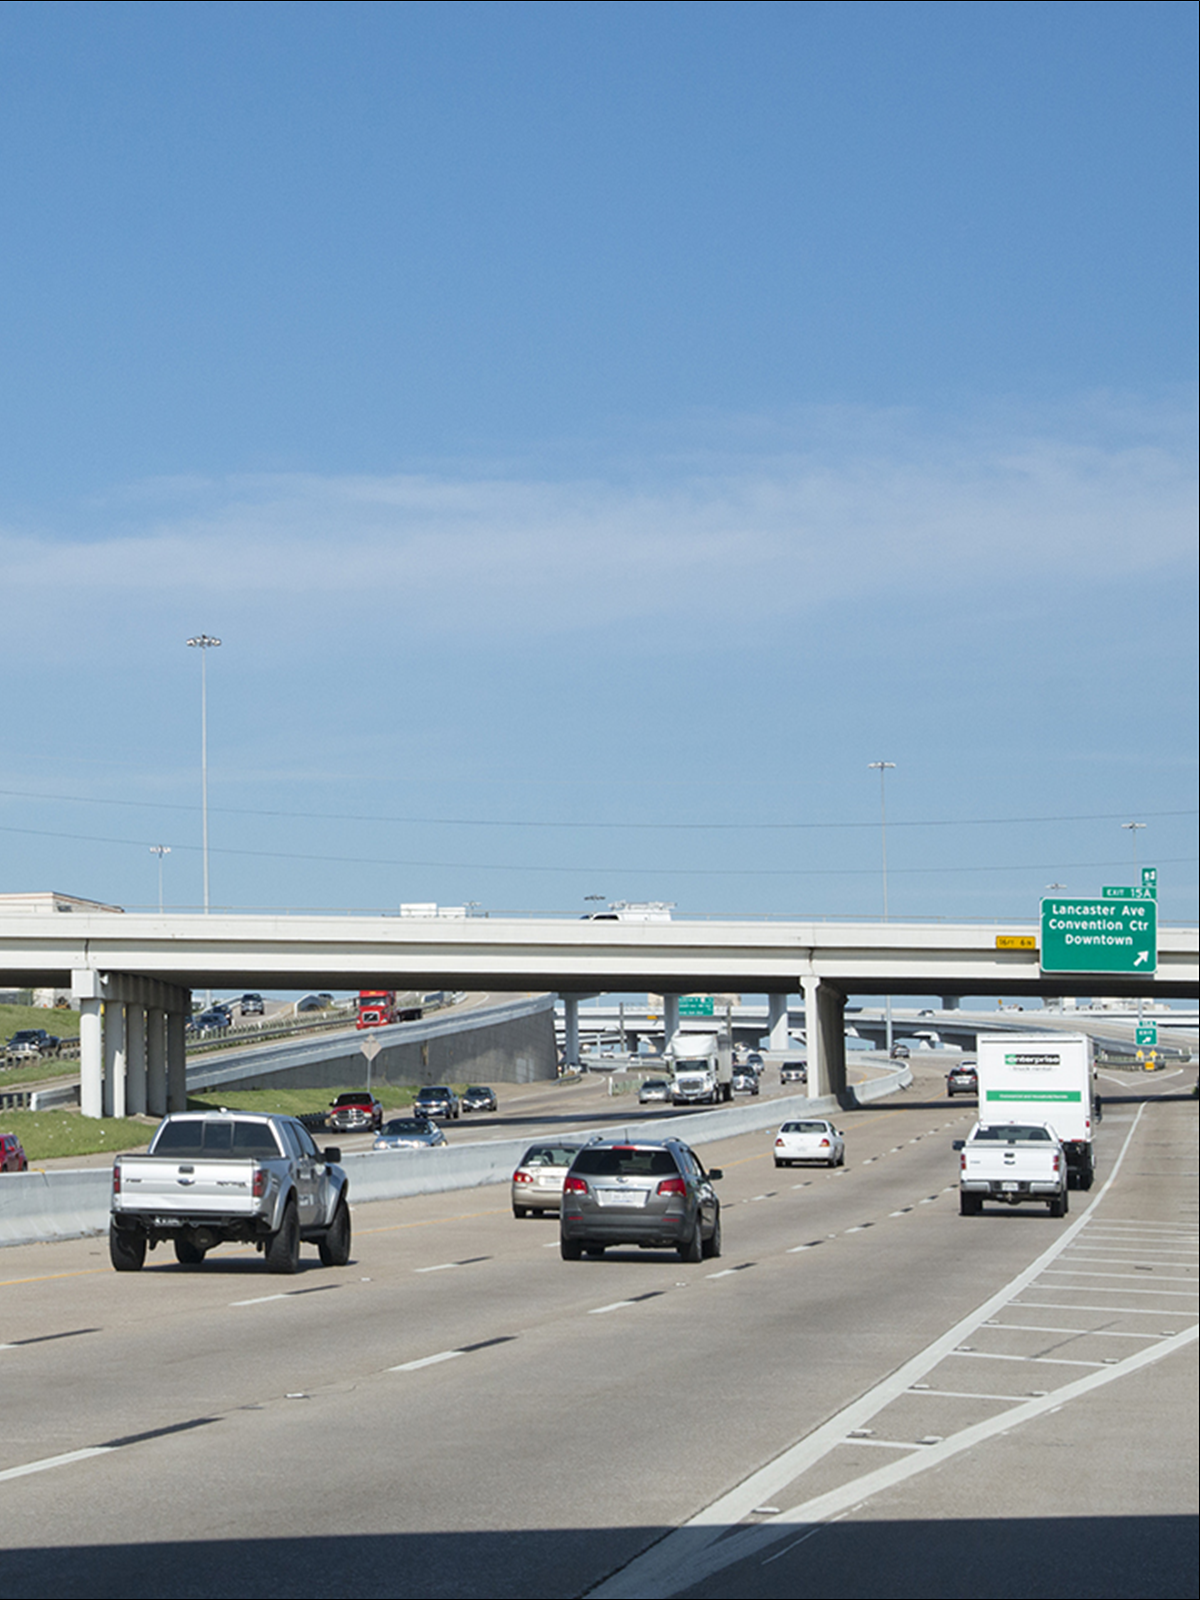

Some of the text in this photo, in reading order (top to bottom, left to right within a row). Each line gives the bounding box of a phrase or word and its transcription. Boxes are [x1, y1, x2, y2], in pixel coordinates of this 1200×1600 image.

[1106, 888, 1152, 898] EXIT 15A
[1052, 904, 1145, 917] Lancaster Ave
[1048, 919, 1149, 931] Convention Ctr
[1065, 933, 1134, 946] Downtown
